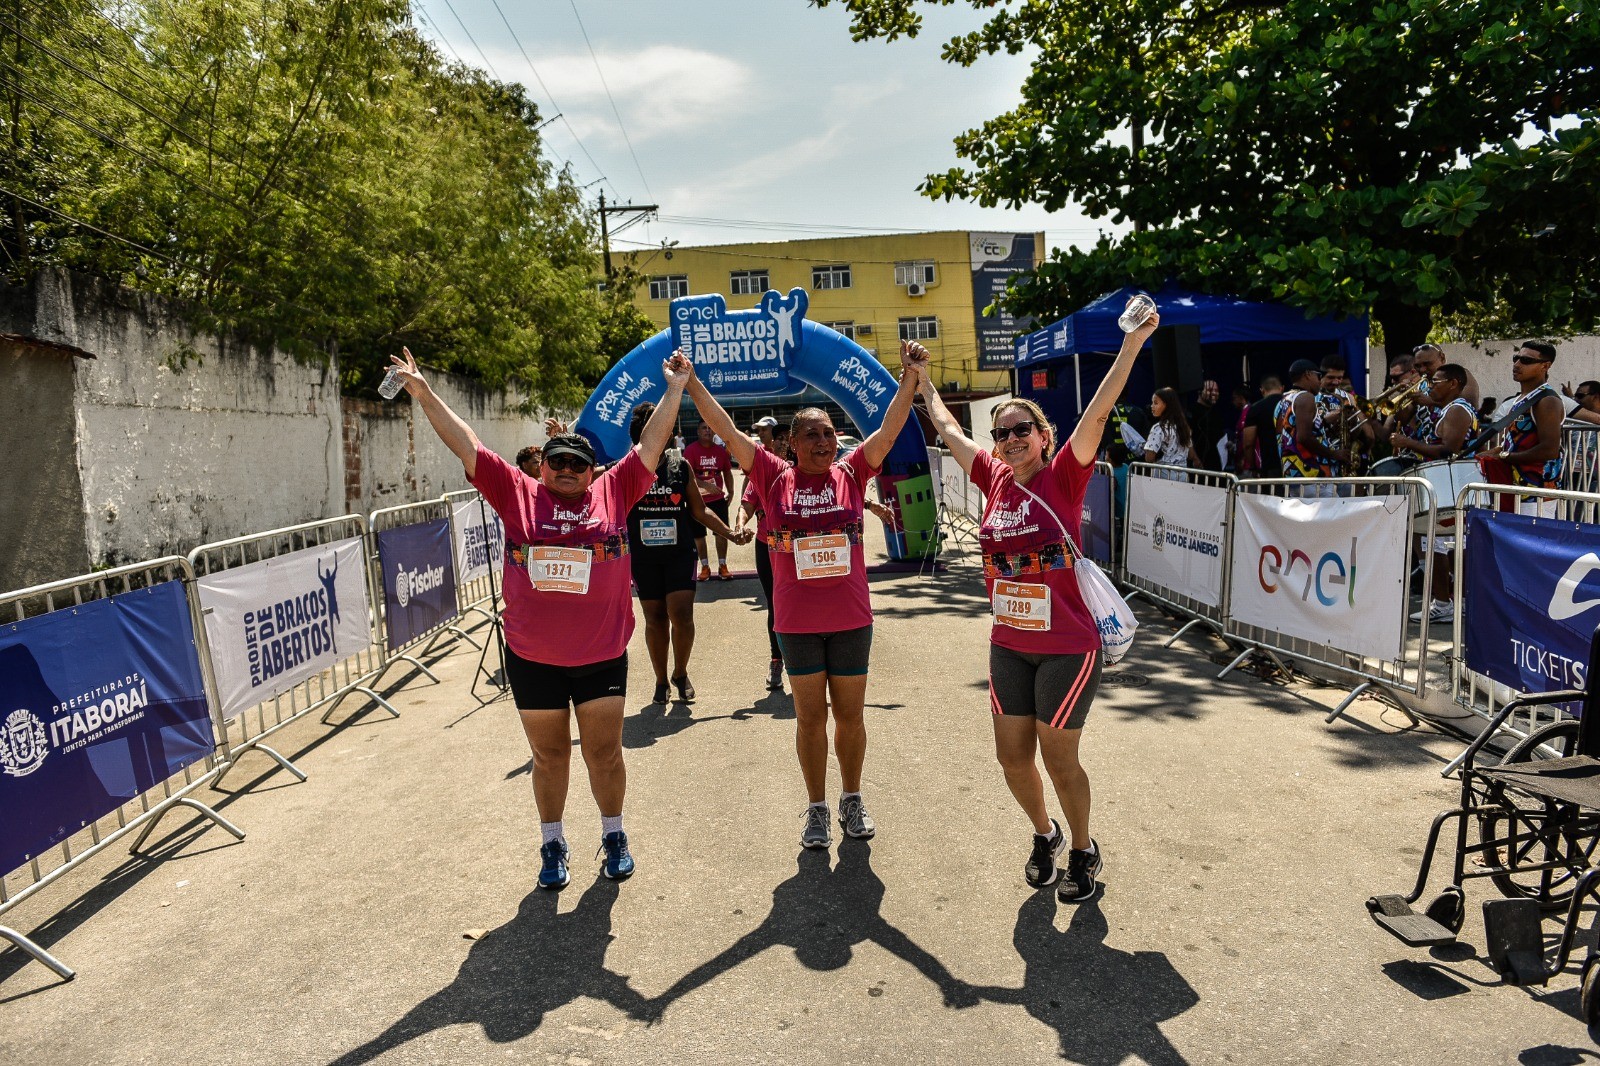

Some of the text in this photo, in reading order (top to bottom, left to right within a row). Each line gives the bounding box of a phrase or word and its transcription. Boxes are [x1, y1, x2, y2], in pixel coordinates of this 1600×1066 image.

[676, 302, 719, 321] enel
[679, 323, 693, 360] ROJETO
[693, 323, 712, 342] DE
[712, 319, 776, 341] BRAÇOS
[694, 339, 777, 365] ABERTOS
[615, 371, 634, 390] UM
[749, 371, 779, 381] JANEIRO
[868, 378, 887, 397] UM
[1165, 531, 1177, 545] RIO
[1178, 535, 1187, 548] DE
[1188, 538, 1219, 557] JANEIRO
[1166, 523, 1220, 543] GOVERNO DO ESTADO
[545, 563, 573, 576] 1371
[811, 550, 837, 564] 1506
[408, 563, 444, 598] Fischer
[1258, 536, 1358, 609] enel
[274, 588, 327, 634] BRAÇOS
[1006, 599, 1032, 614] 1289
[256, 606, 275, 641] DE
[243, 611, 262, 688] PROJETO
[261, 619, 331, 681] ABERTOS
[52, 672, 139, 715] PREFEITURA DE
[50, 678, 148, 748] ITABORAÍ
[62, 711, 145, 755] JUNTOS PARA TRANSFORMAR!
